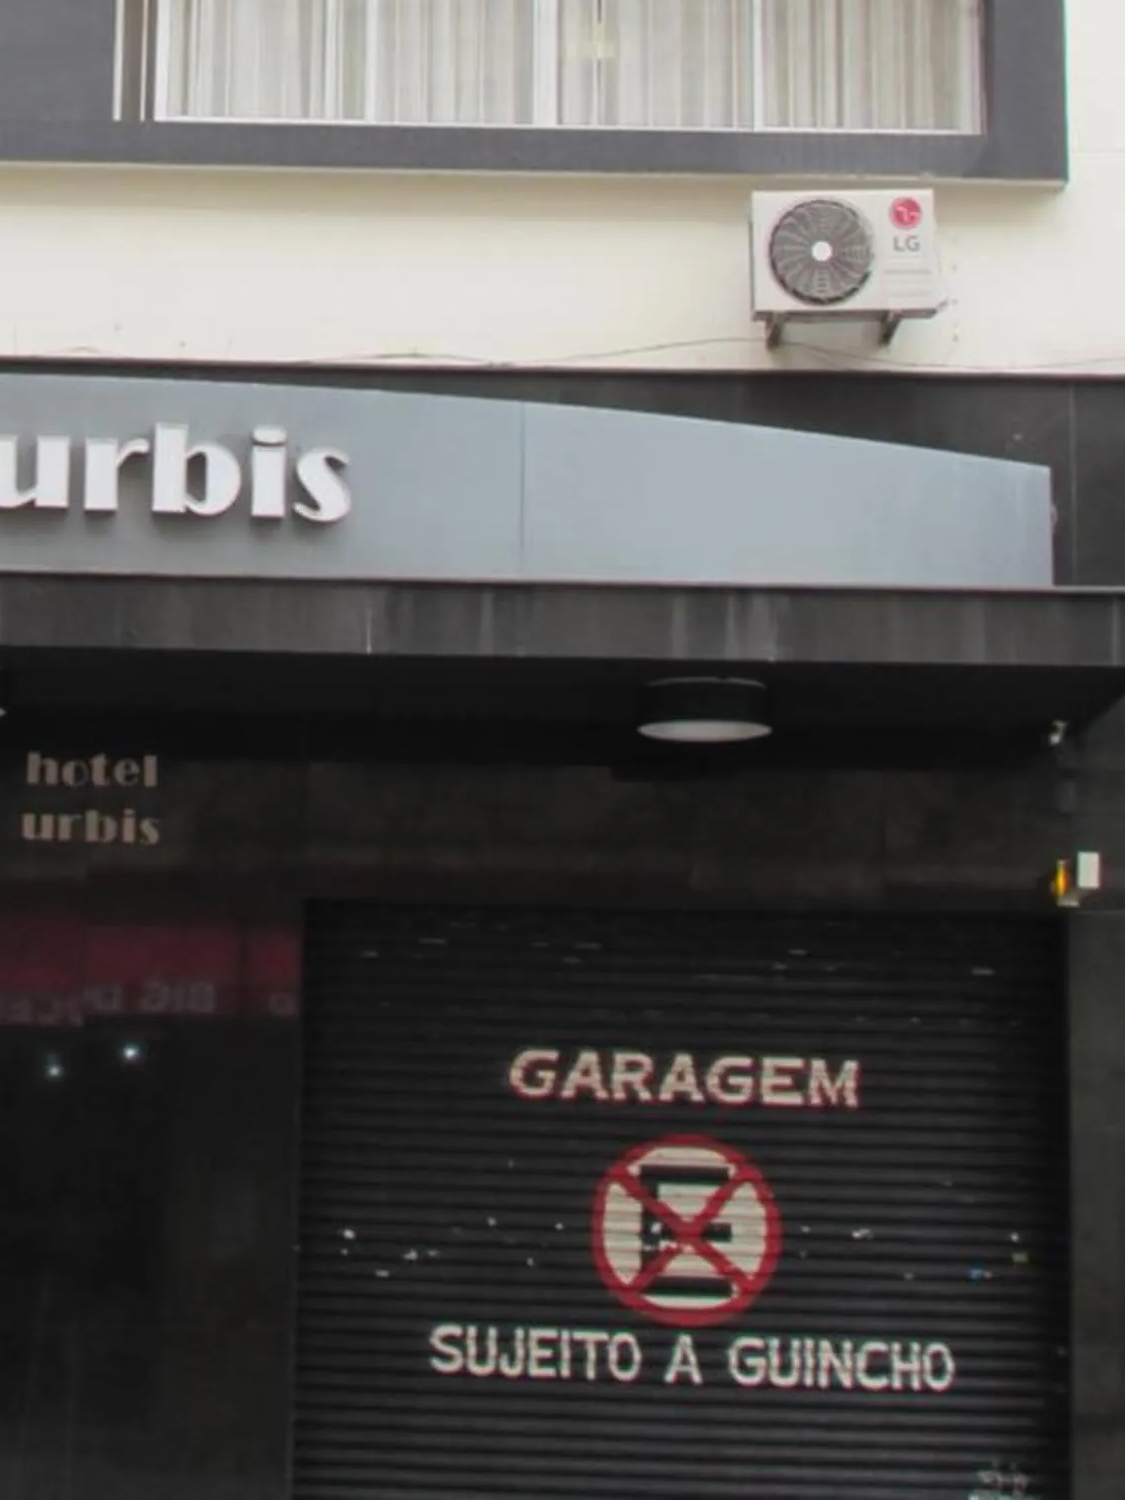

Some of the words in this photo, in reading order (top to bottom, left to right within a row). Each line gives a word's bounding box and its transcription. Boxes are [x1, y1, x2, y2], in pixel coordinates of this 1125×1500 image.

[893, 235, 921, 252] LG
[26, 751, 158, 788] hotel
[22, 808, 161, 845] urbis
[509, 1049, 861, 1108] GARAGEM
[430, 1324, 642, 1381] SUJEITO
[665, 1334, 702, 1384] A
[728, 1337, 956, 1390] GUINCHO
